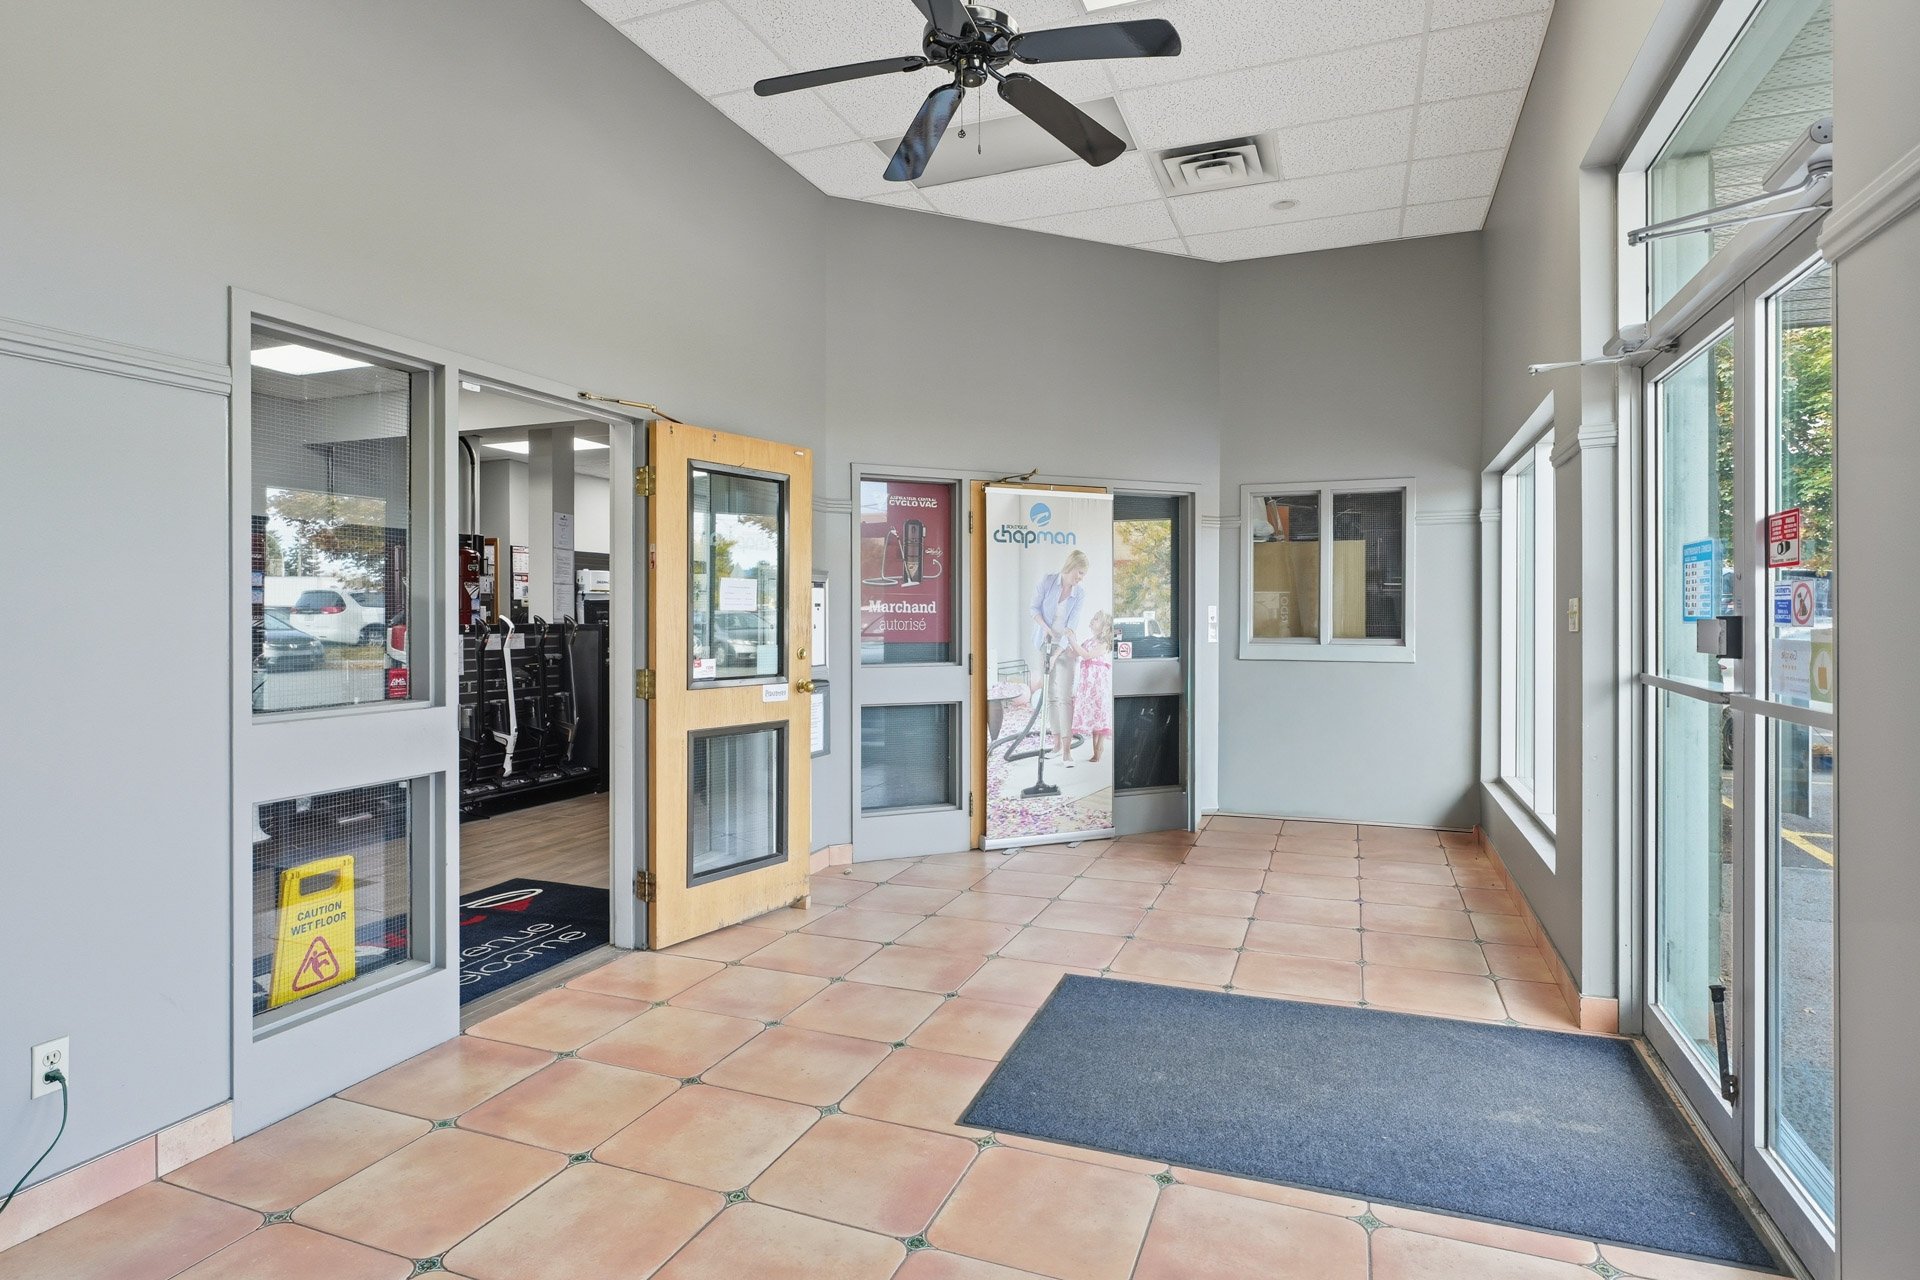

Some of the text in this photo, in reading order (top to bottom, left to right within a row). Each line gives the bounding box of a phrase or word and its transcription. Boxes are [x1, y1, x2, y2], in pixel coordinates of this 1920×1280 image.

[889, 499, 938, 508] CYCLO VAC
[993, 524, 1076, 549] chapman
[868, 599, 937, 614] Marchand
[879, 617, 927, 631] autorisé
[297, 901, 342, 922] CAUTION
[291, 911, 347, 936] WET FLOOR
[459, 931, 587, 986] elcome
